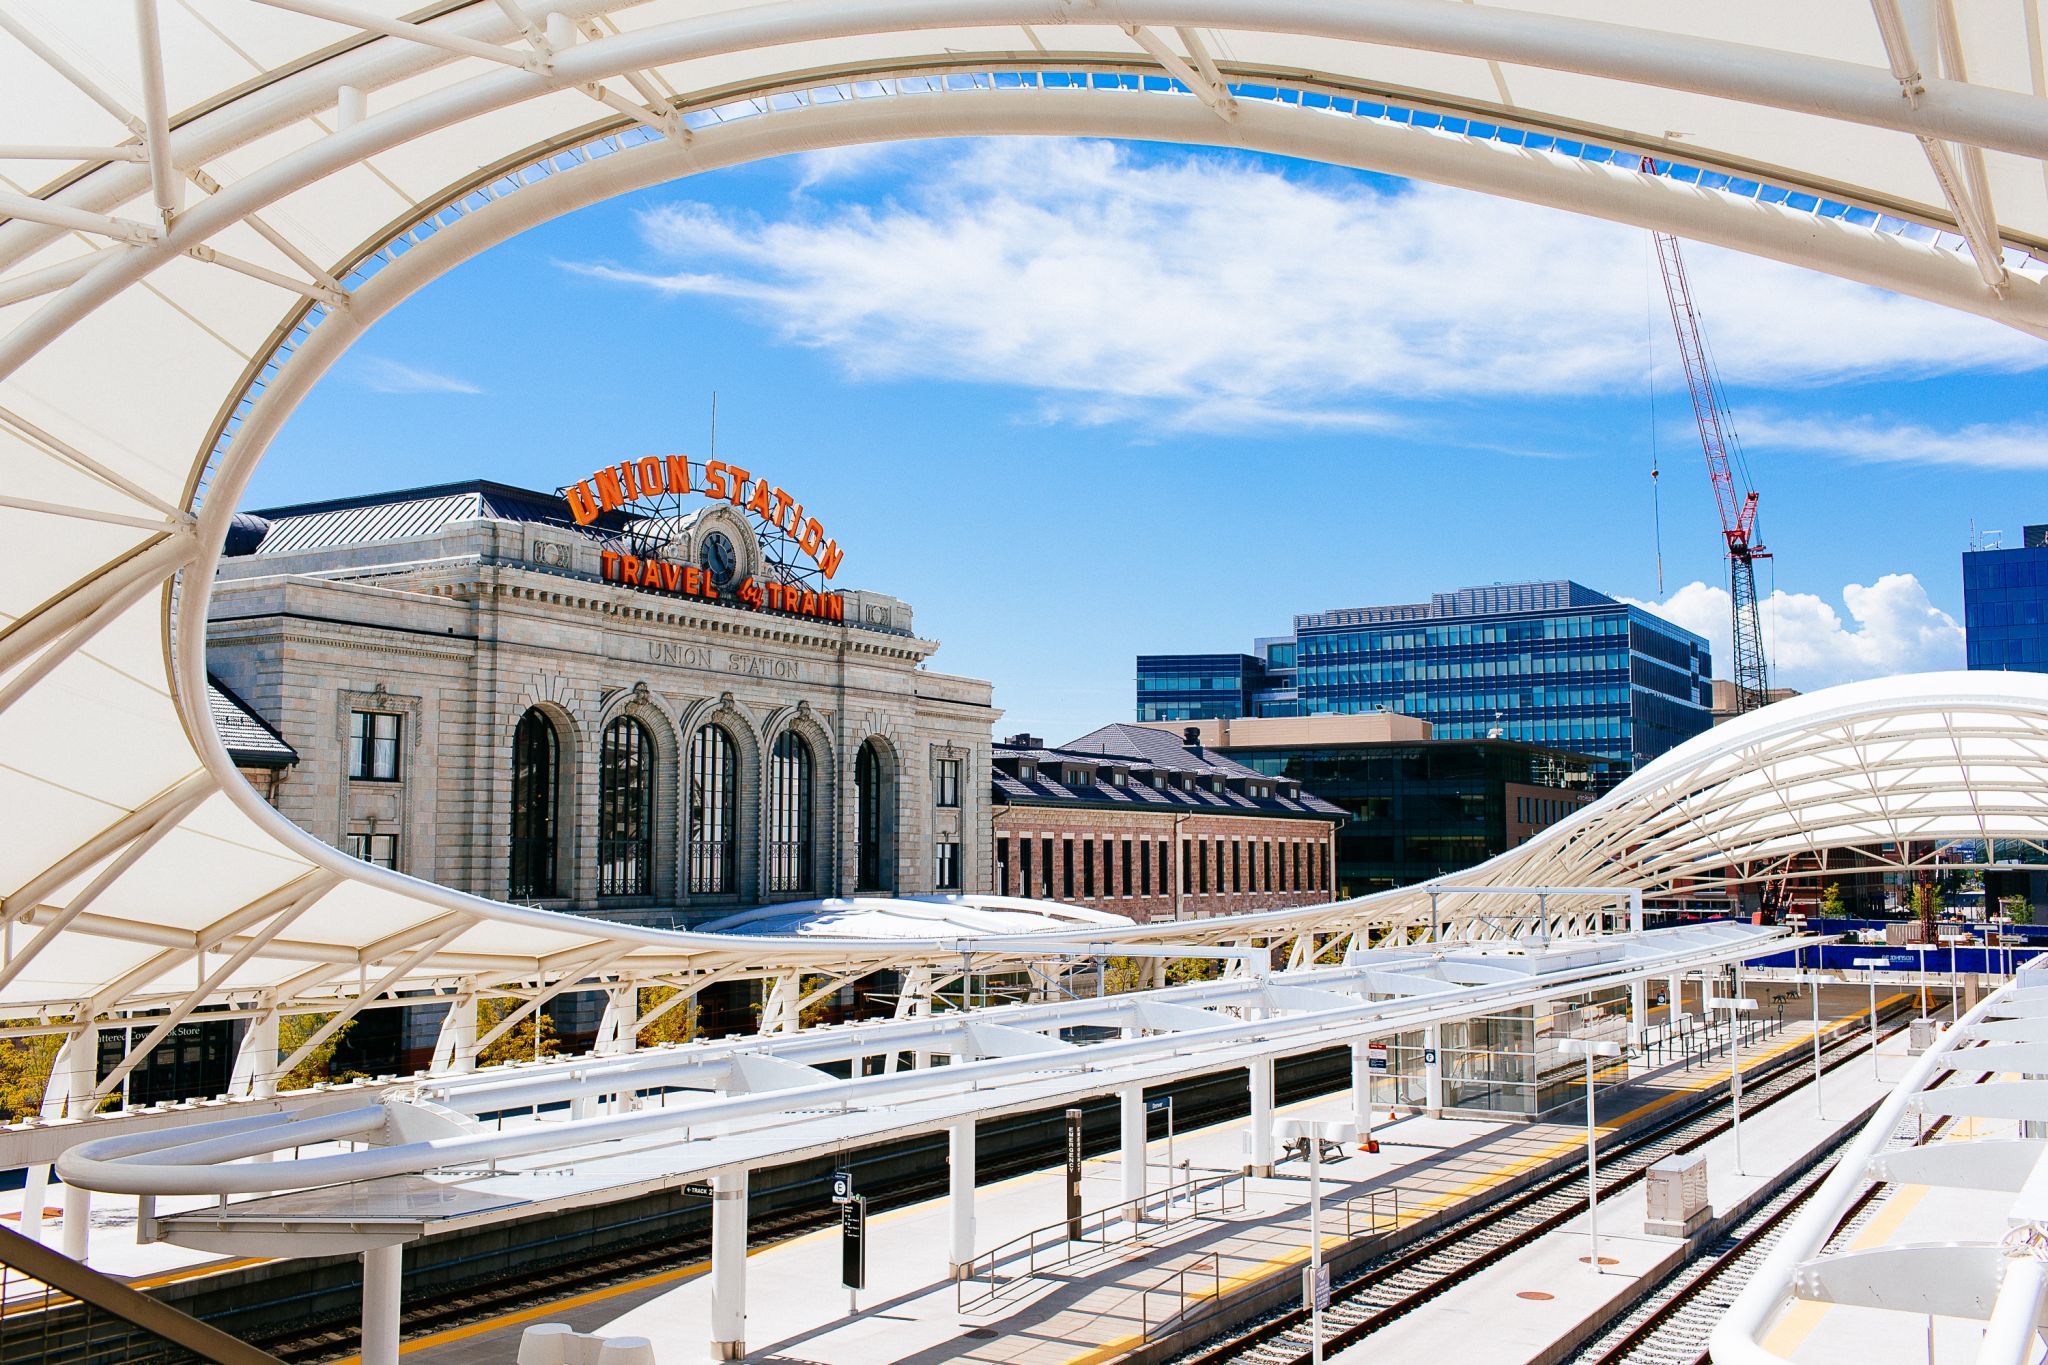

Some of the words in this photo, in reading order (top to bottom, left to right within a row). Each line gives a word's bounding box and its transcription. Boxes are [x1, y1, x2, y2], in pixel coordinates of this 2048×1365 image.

[565, 454, 691, 526] UNION
[704, 459, 844, 580] STATION
[601, 550, 719, 599] TRAVEL
[736, 575, 764, 611] by
[765, 581, 843, 621] TRAIN
[648, 641, 712, 667] UNION
[728, 654, 800, 679] STATION
[98, 1034, 126, 1043] attered
[177, 1027, 200, 1036] Store
[691, 1187, 708, 1195] TRACK
[837, 1183, 843, 1193] E
